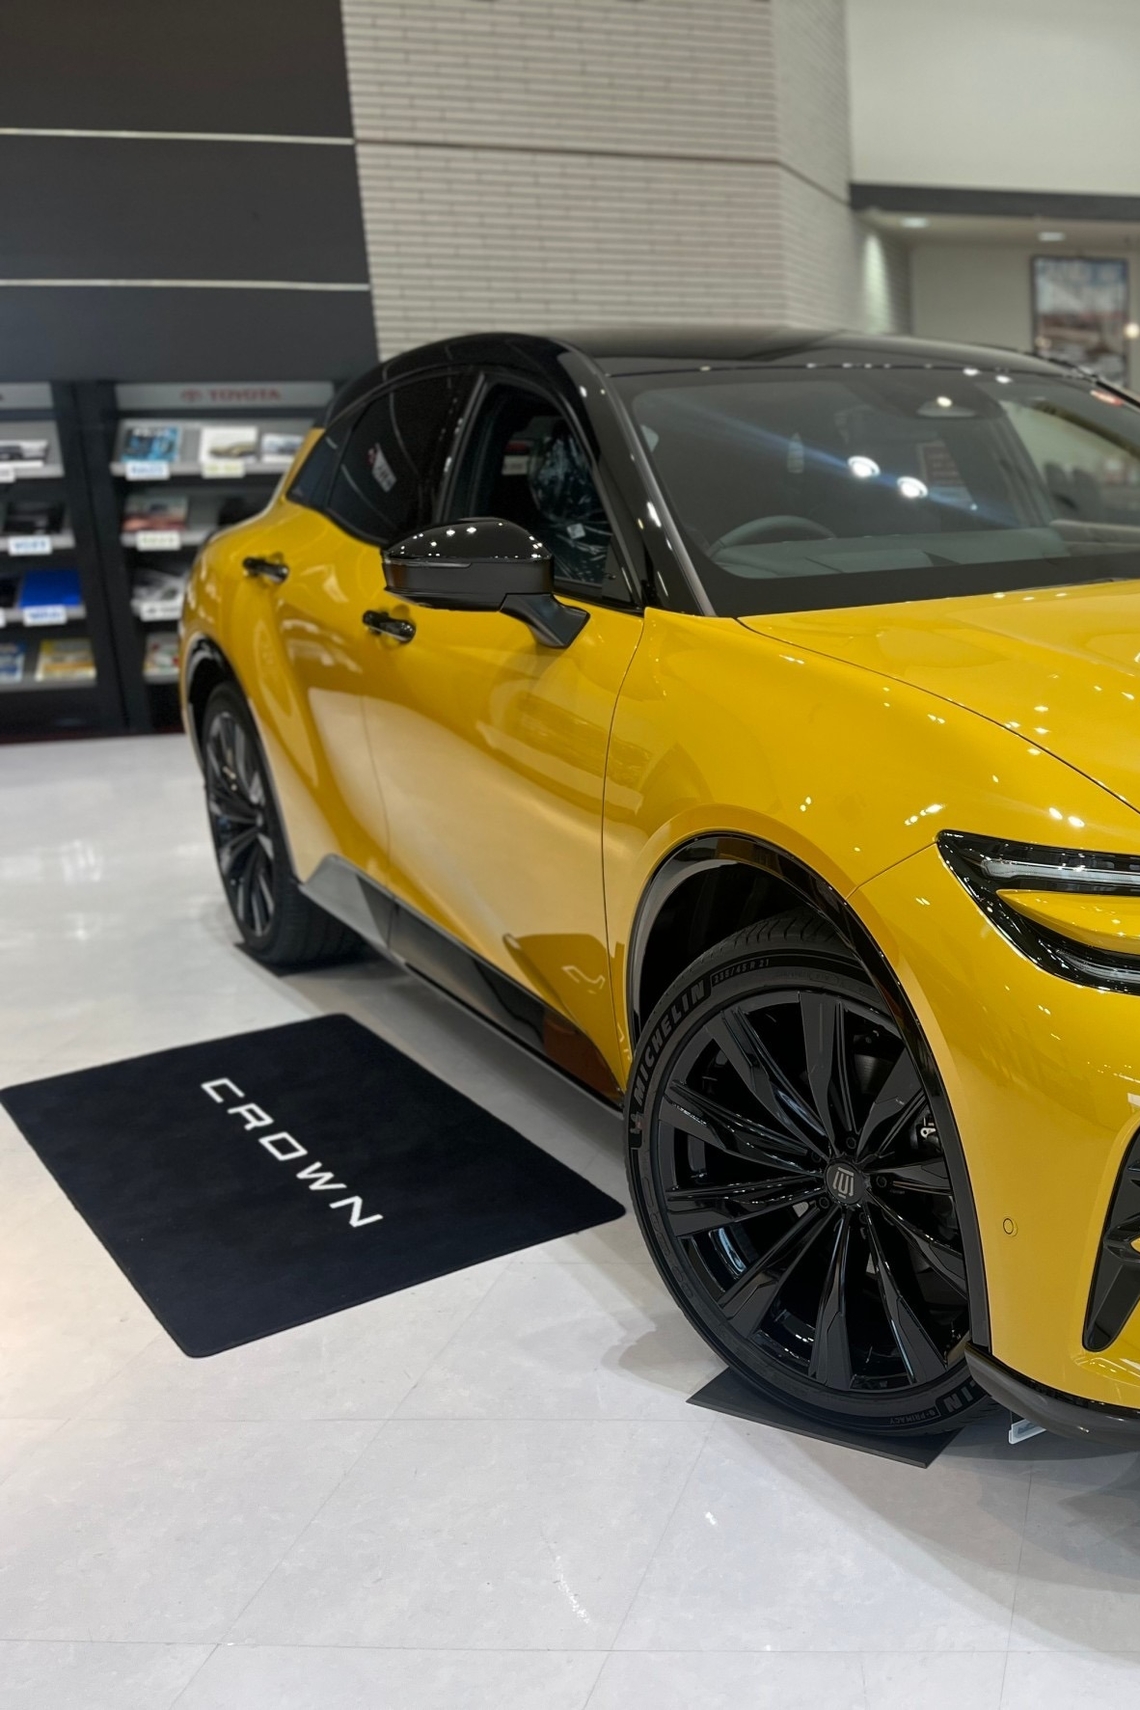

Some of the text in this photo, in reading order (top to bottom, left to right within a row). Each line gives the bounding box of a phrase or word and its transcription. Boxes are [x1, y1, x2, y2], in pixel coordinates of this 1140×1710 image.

[210, 389, 281, 401] TOYOTA
[633, 980, 705, 1107] MICHELIN
[201, 1077, 384, 1228] CROWN
